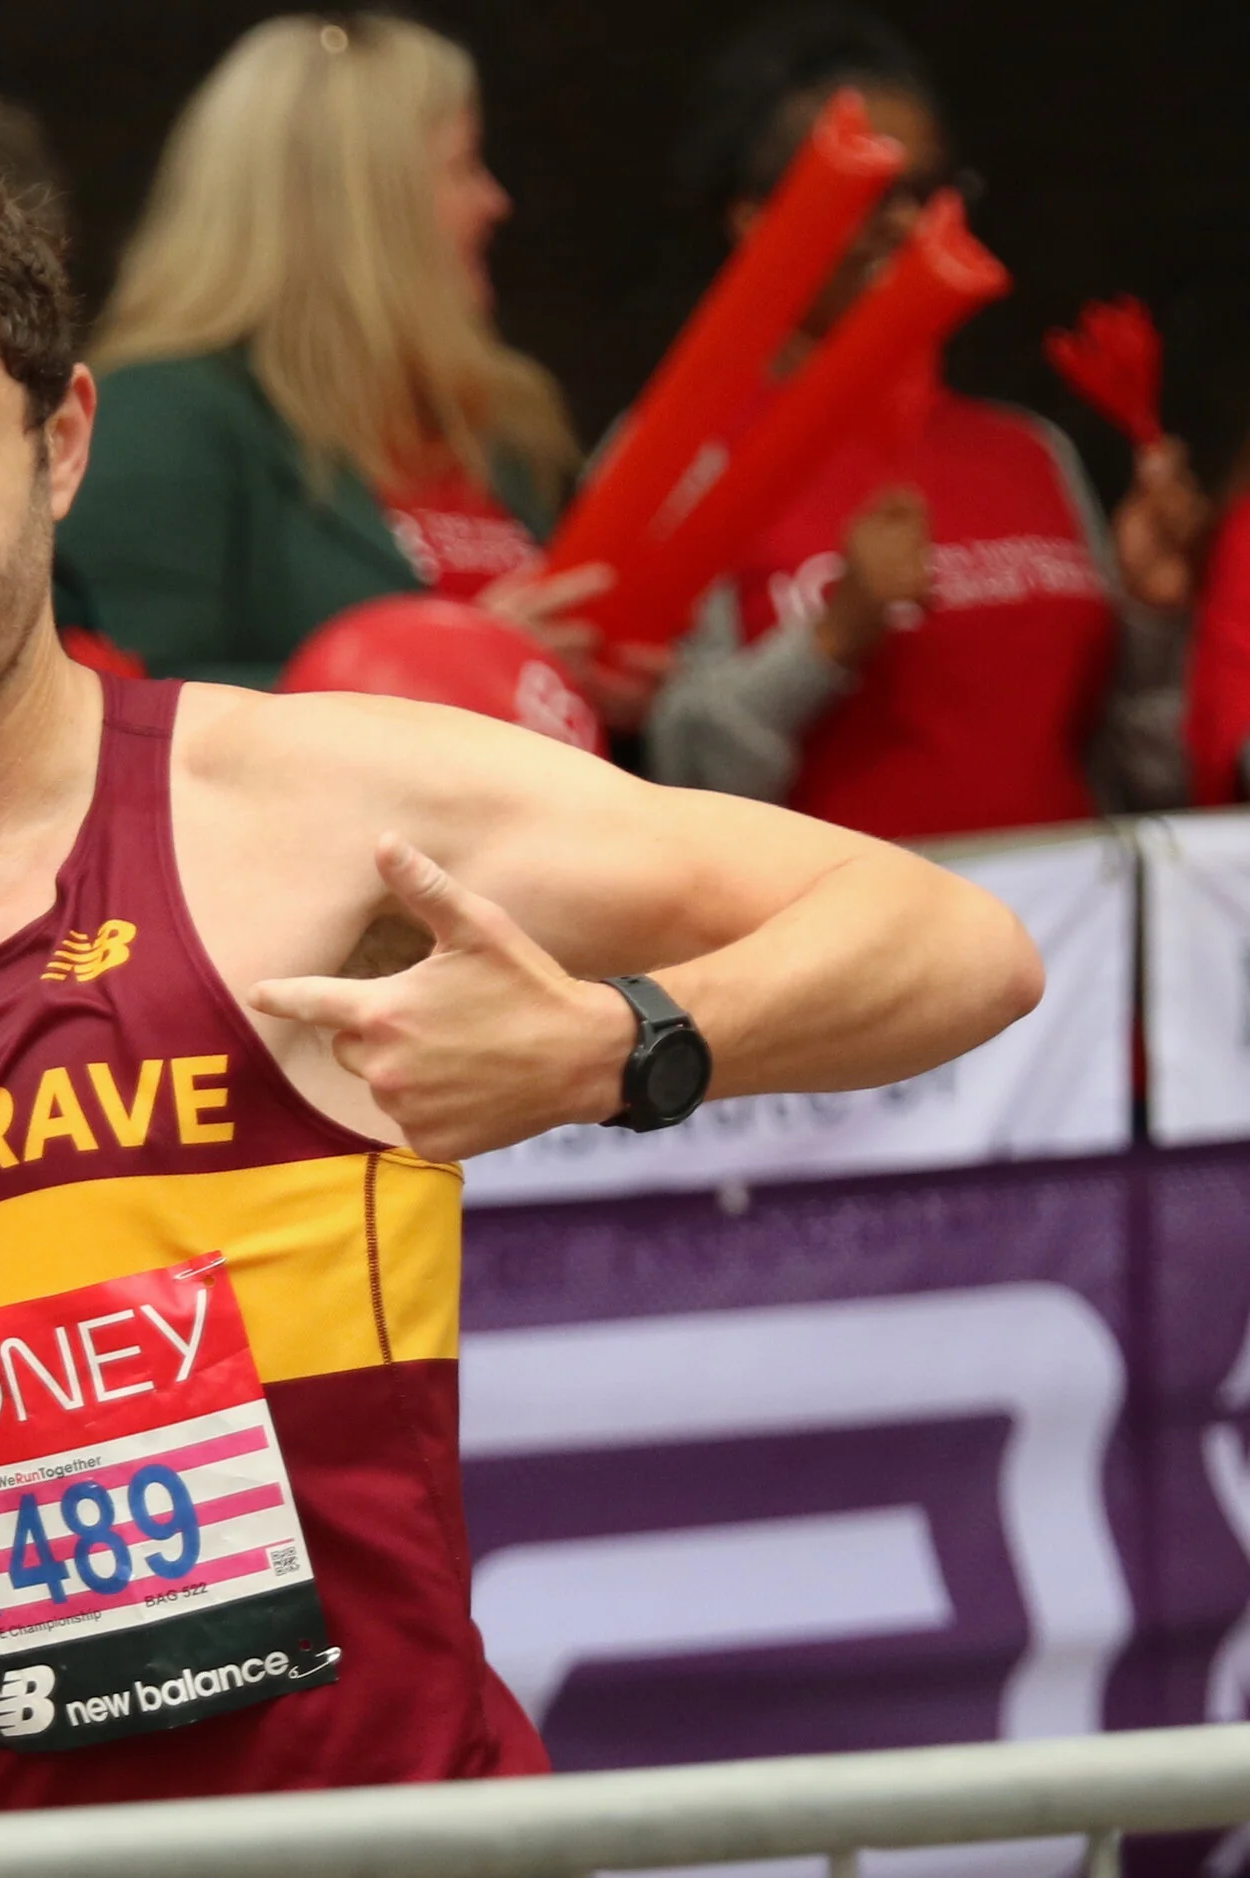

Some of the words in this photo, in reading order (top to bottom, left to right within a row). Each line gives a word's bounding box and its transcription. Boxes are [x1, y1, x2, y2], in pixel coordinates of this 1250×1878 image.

[144, 1587, 180, 1608] BAG
[181, 1582, 209, 1600] 522
[10, 1609, 103, 1638] Championship
[65, 1687, 132, 1726] new
[136, 1650, 290, 1711] balance
